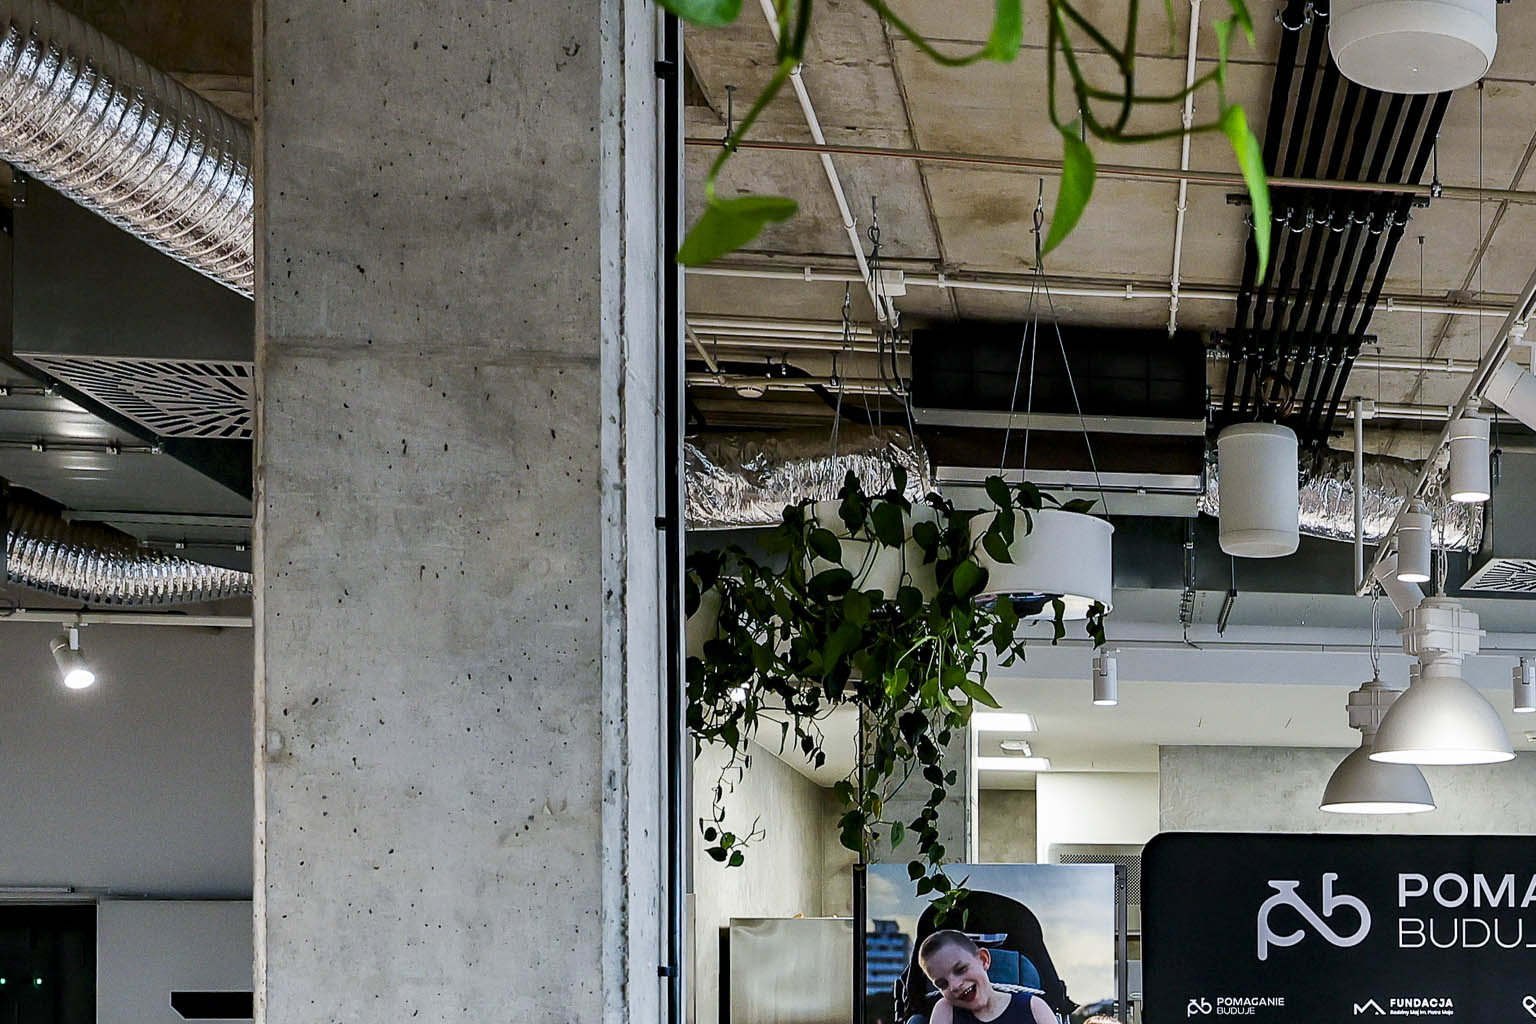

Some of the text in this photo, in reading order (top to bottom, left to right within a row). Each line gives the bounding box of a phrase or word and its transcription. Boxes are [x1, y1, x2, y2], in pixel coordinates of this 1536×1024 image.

[1216, 997, 1285, 1006] POMAGANIE
[1390, 998, 1453, 1008] FUNDACJA
[1216, 1007, 1256, 1015] BUDUJE
